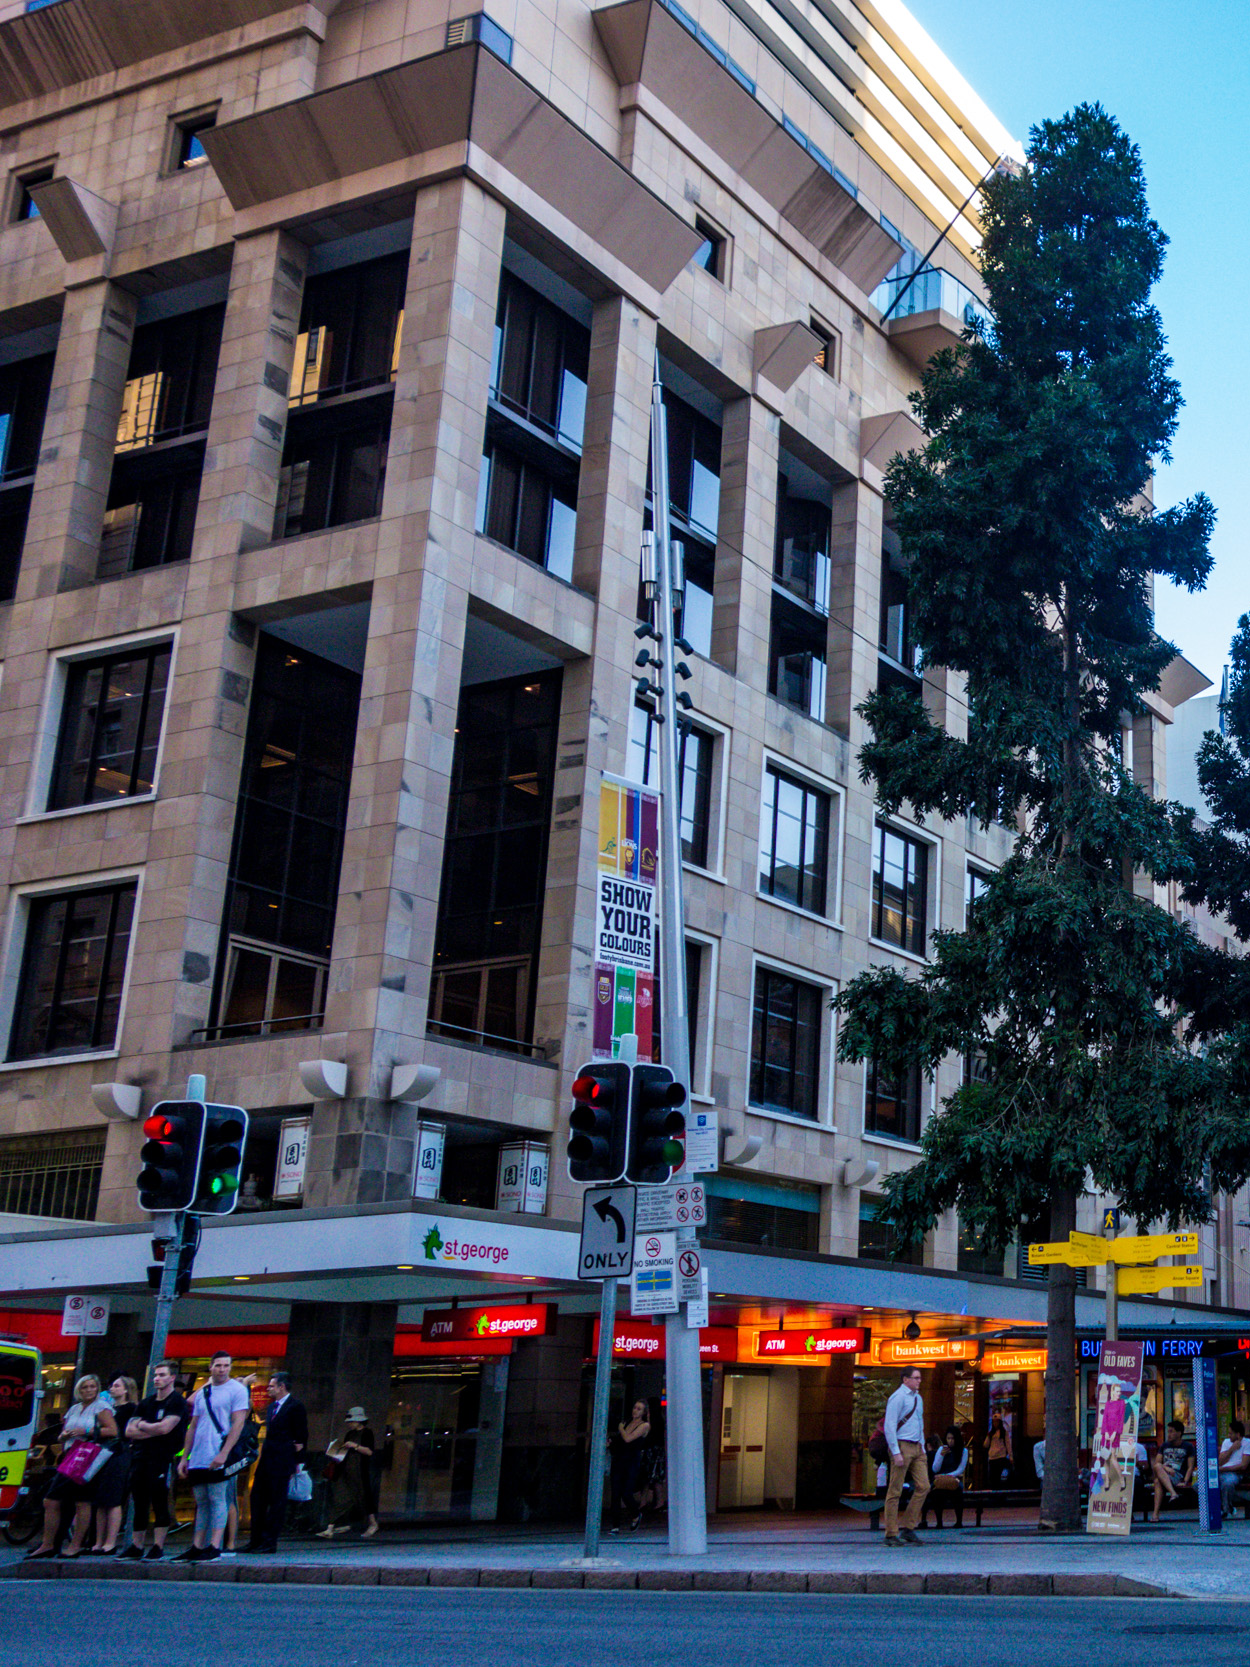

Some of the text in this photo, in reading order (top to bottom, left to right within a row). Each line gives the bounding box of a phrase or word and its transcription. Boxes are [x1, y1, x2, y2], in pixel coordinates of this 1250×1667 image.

[601, 880, 652, 913] SHOW
[601, 905, 651, 939] YOUR
[600, 932, 651, 957] COLOURS
[444, 1239, 509, 1264] st.george
[583, 1252, 628, 1269] ONLY
[634, 1258, 674, 1268] NO SMOKING
[431, 1318, 537, 1334] ATM st.george
[615, 1335, 659, 1352] st.george
[766, 1338, 857, 1350] ATM st.george
[896, 1343, 945, 1356] bankwest
[1162, 1340, 1204, 1356] FERRY
[996, 1355, 1042, 1367] bankwest
[1104, 1355, 1136, 1368] OLD FAVES
[1093, 1500, 1128, 1514] NEW FINDS
